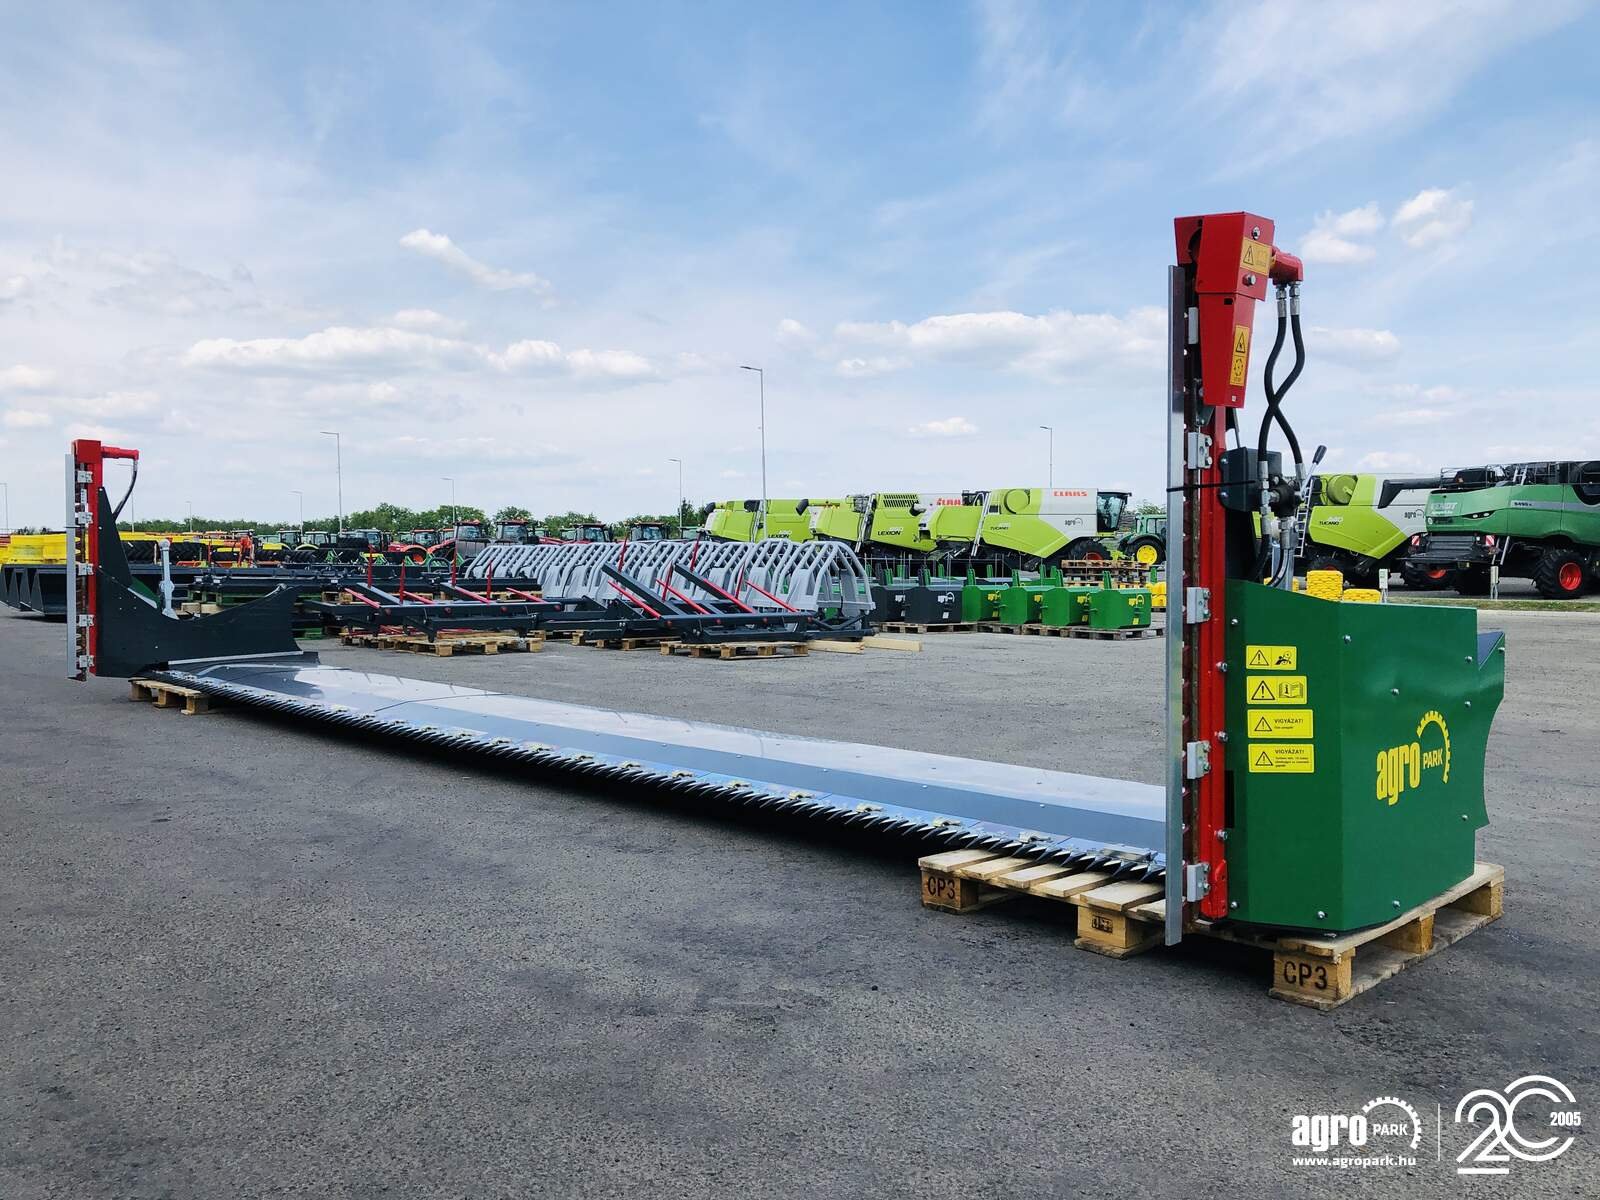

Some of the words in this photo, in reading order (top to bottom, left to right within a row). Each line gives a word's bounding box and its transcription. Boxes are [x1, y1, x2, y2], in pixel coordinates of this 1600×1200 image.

[1376, 741, 1421, 806] agro
[1423, 748, 1443, 770] PARK
[927, 876, 956, 900] CP3
[1283, 960, 1328, 990] CP3
